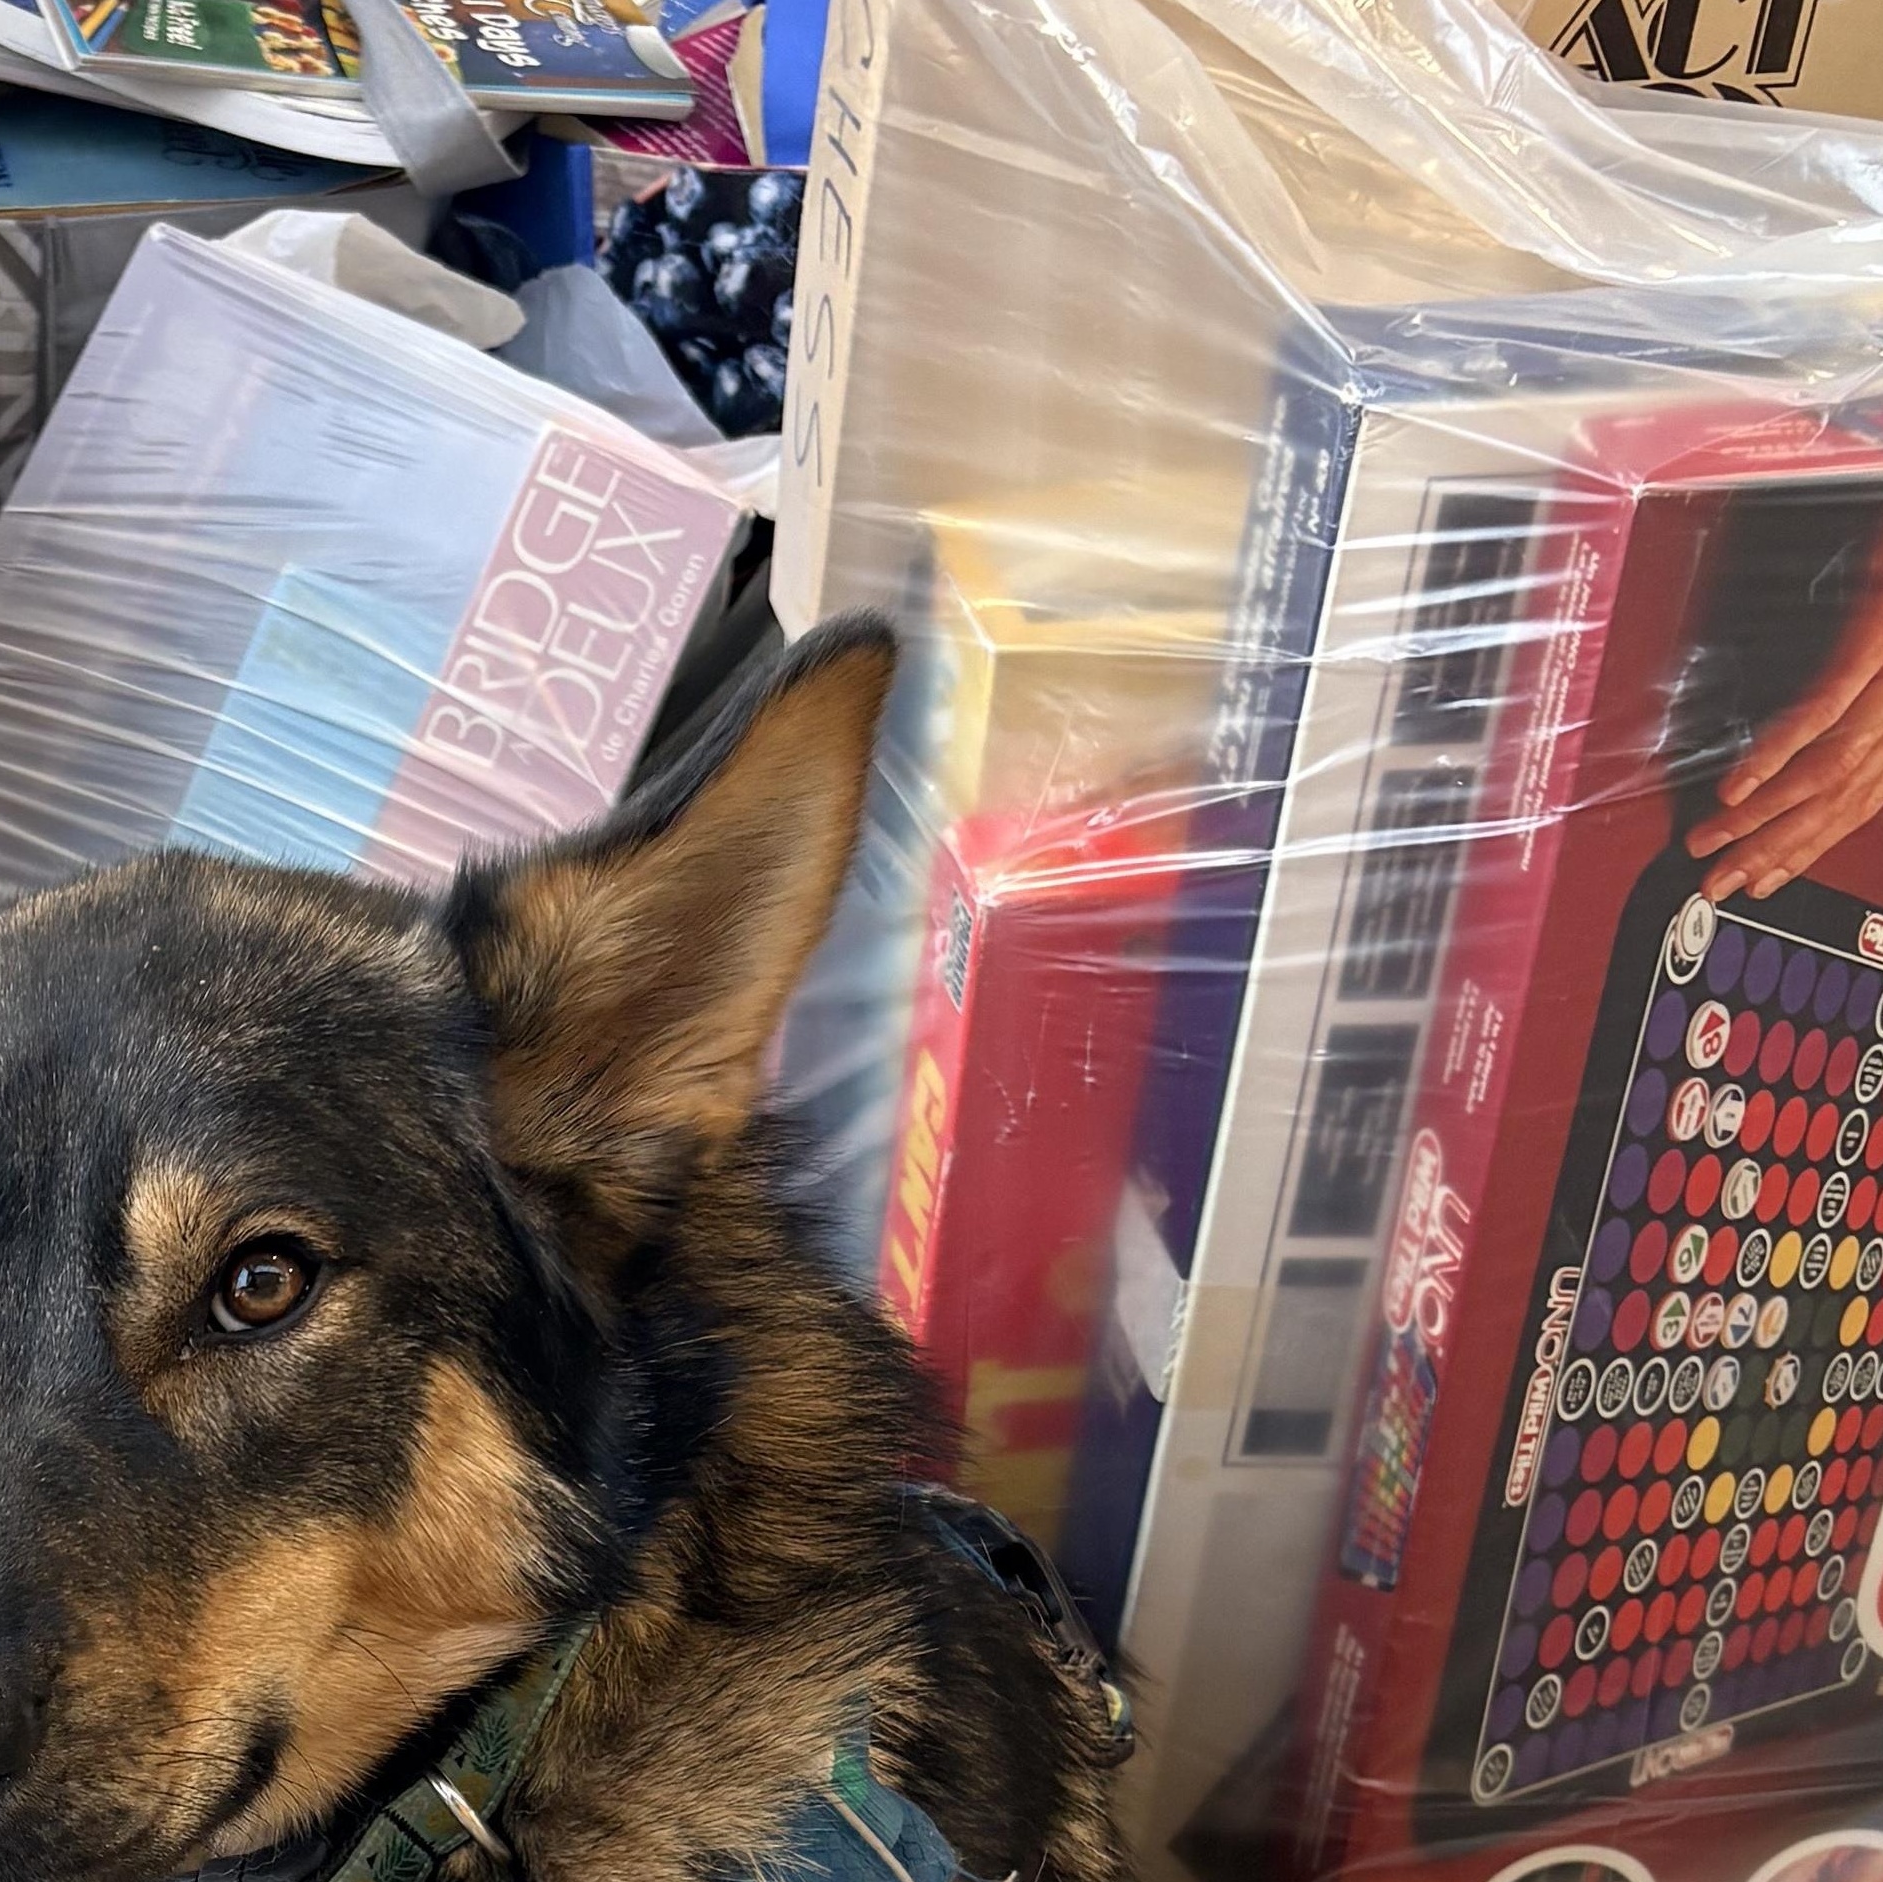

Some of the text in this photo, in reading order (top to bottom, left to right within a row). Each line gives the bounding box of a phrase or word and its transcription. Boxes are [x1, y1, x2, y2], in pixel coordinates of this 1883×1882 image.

[476, 11, 541, 68] Days
[422, 443, 622, 769] BRIDGE
[521, 502, 686, 750] DEUX
[600, 552, 708, 763] de Charles Goren
[1416, 1183, 1471, 1347] UNO
[1535, 1266, 1581, 1366] UNO
[1523, 1376, 1551, 1435] Wild
